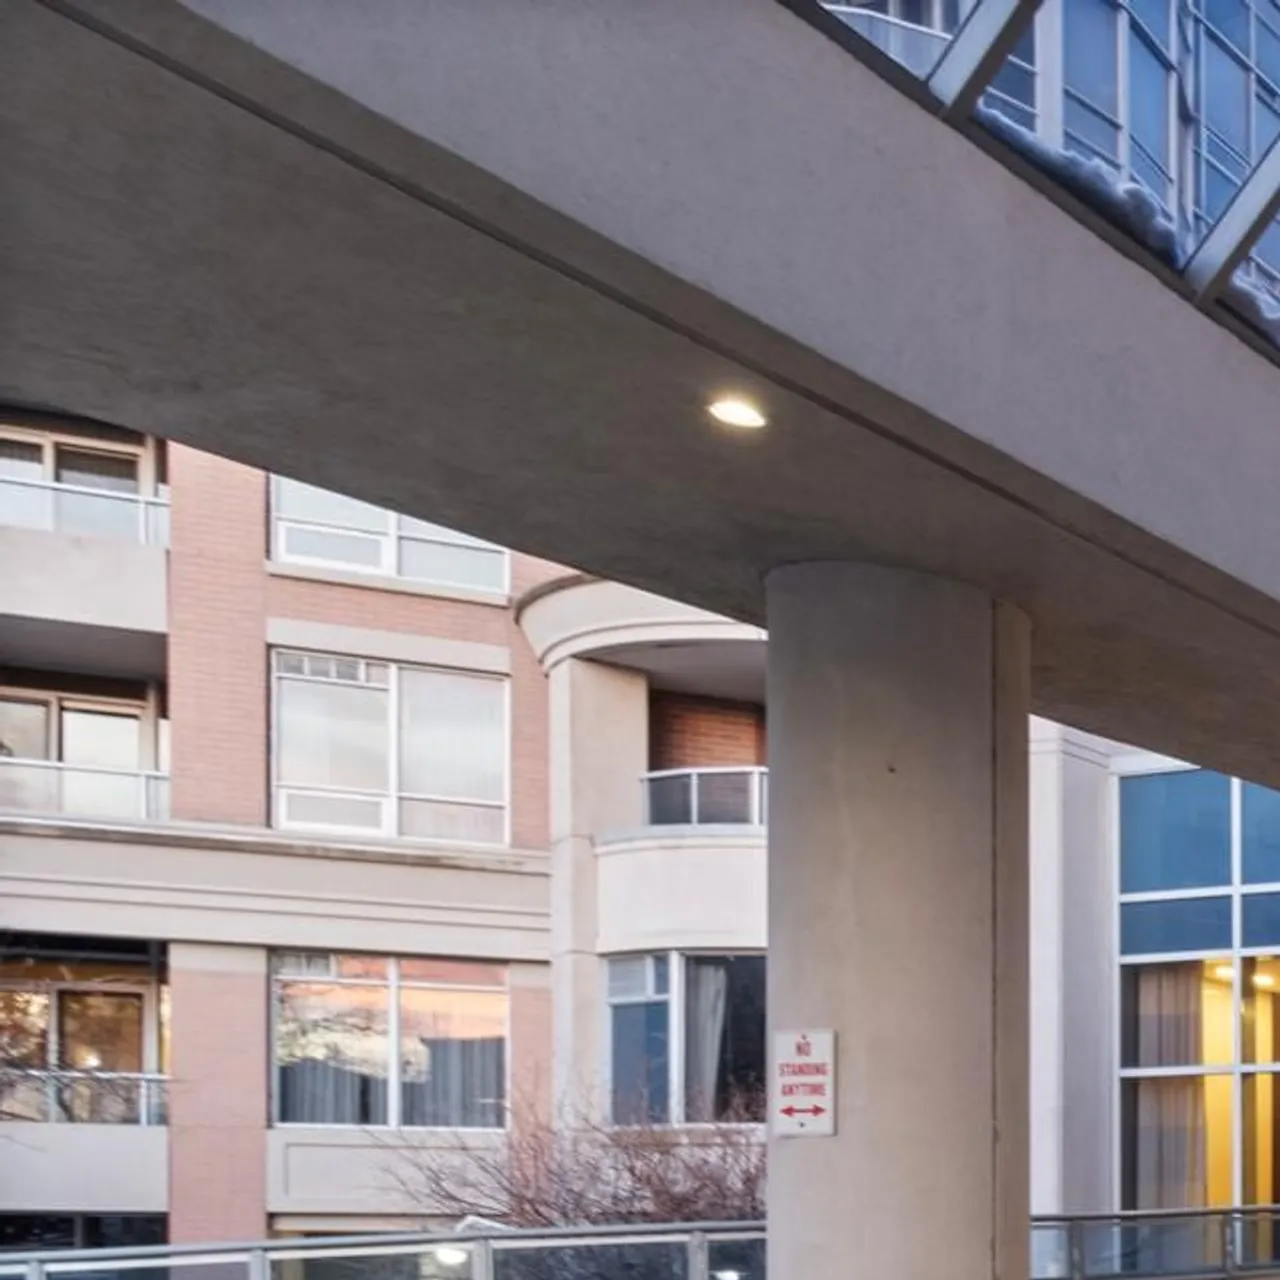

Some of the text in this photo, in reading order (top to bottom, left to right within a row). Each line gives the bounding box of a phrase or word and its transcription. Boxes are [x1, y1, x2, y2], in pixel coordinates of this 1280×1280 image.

[795, 1041, 812, 1057] NO
[778, 1062, 829, 1077] STANDING
[781, 1082, 827, 1097] ANYTIME
